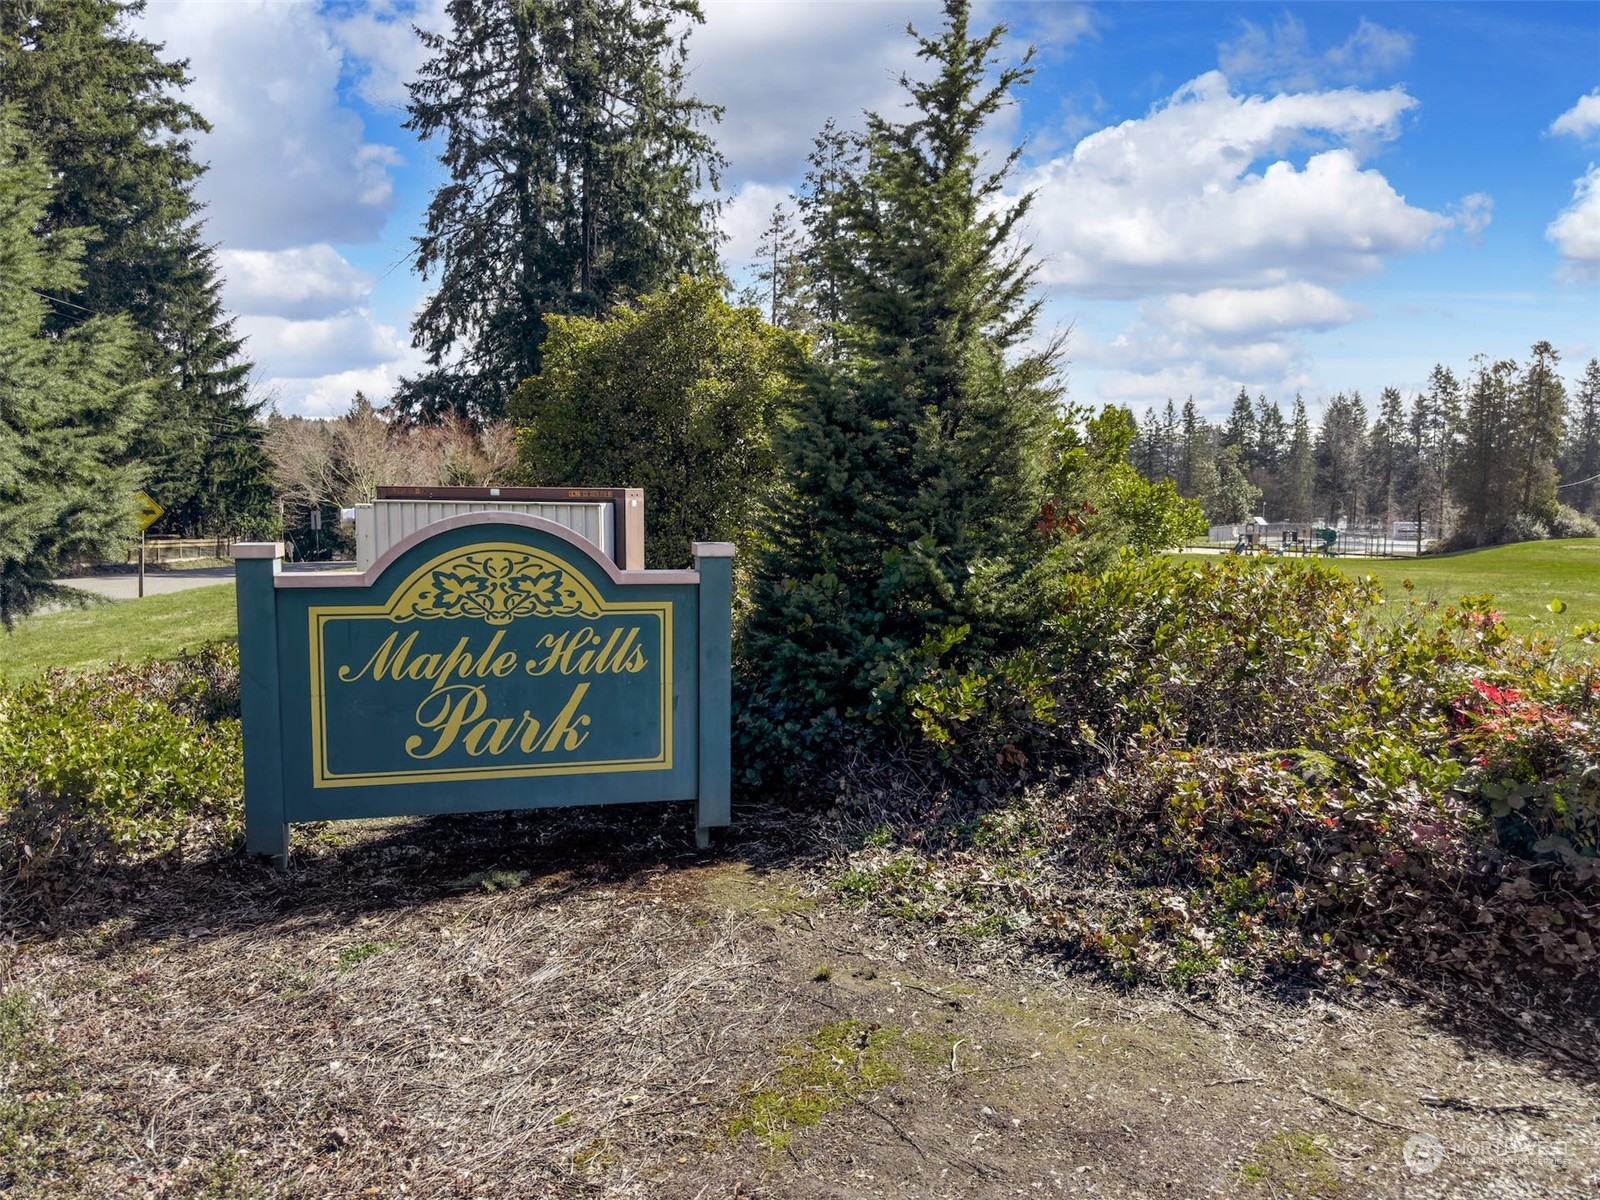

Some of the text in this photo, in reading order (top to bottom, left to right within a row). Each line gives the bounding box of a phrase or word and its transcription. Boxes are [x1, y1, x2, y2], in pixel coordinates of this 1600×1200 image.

[338, 627, 648, 693] Maple Hills
[405, 682, 591, 760] Park
